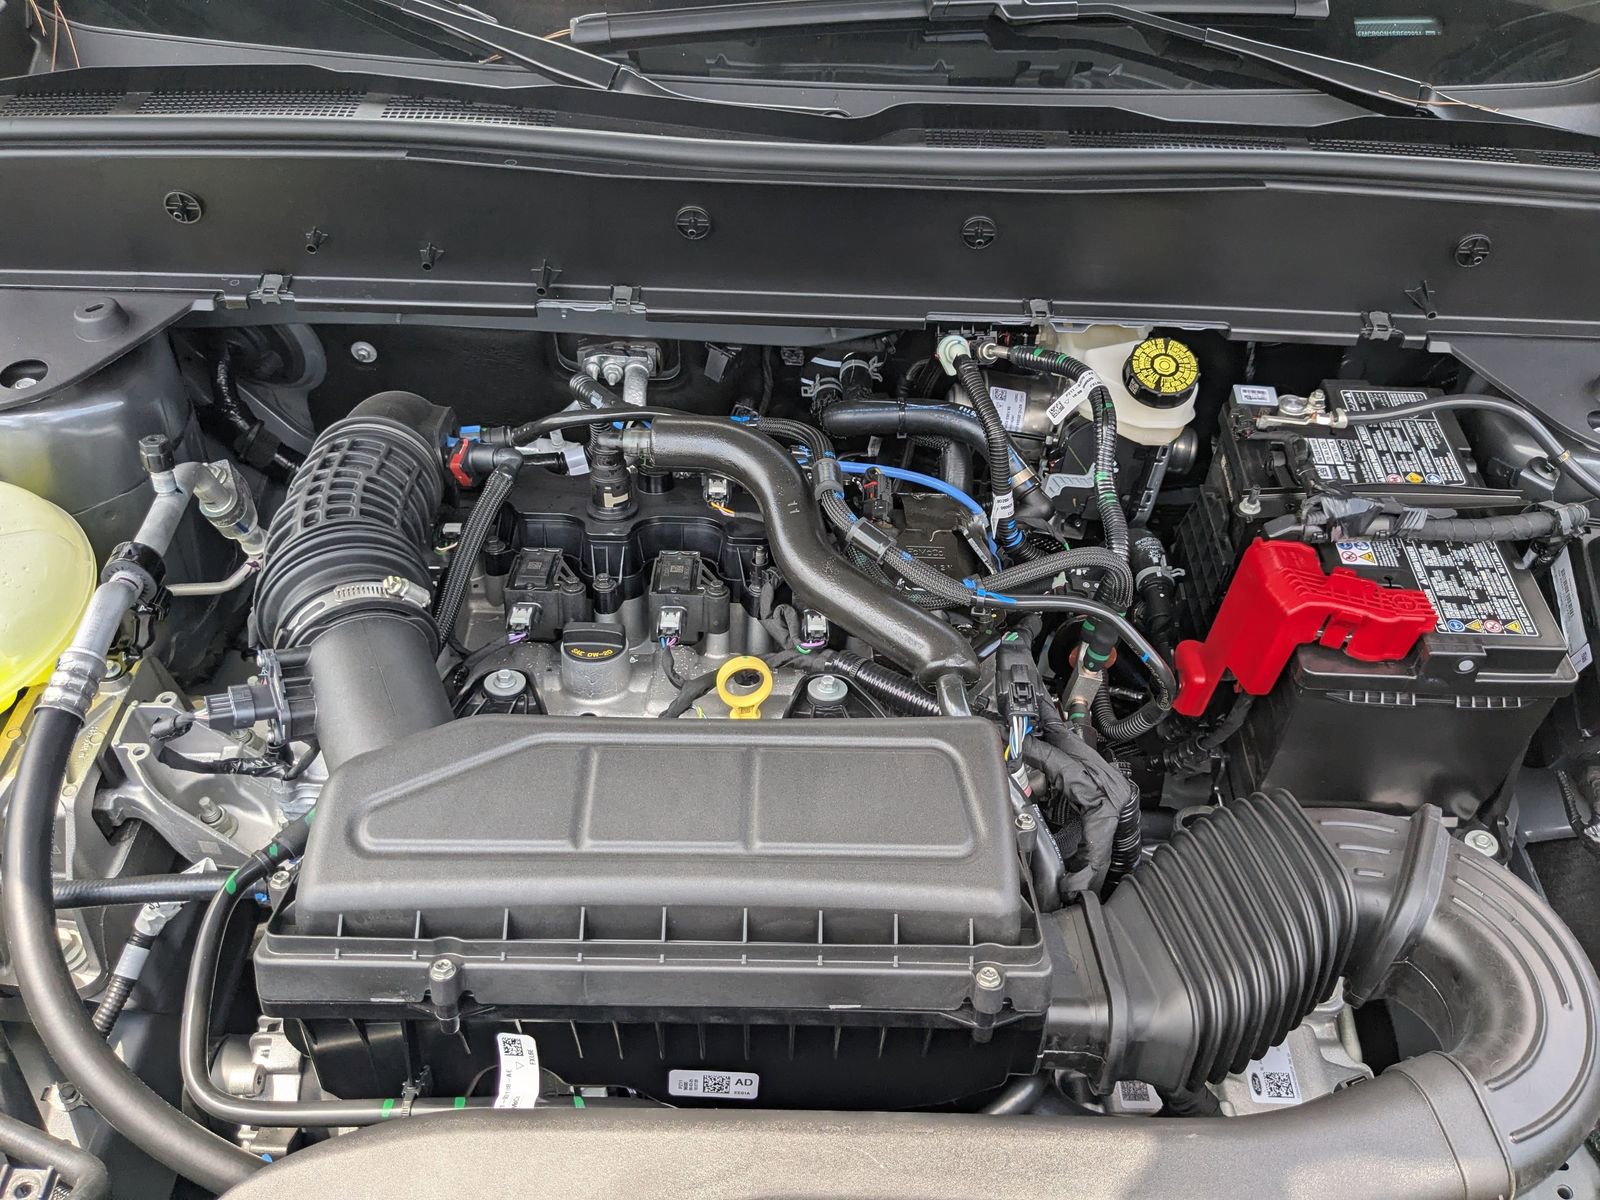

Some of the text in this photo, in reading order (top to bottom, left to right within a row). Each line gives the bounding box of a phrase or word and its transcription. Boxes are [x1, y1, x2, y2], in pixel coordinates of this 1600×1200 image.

[1341, 440, 1352, 461] FoMoCo
[571, 648, 613, 658] SAE 0W-20
[735, 1078, 753, 1086] AD
